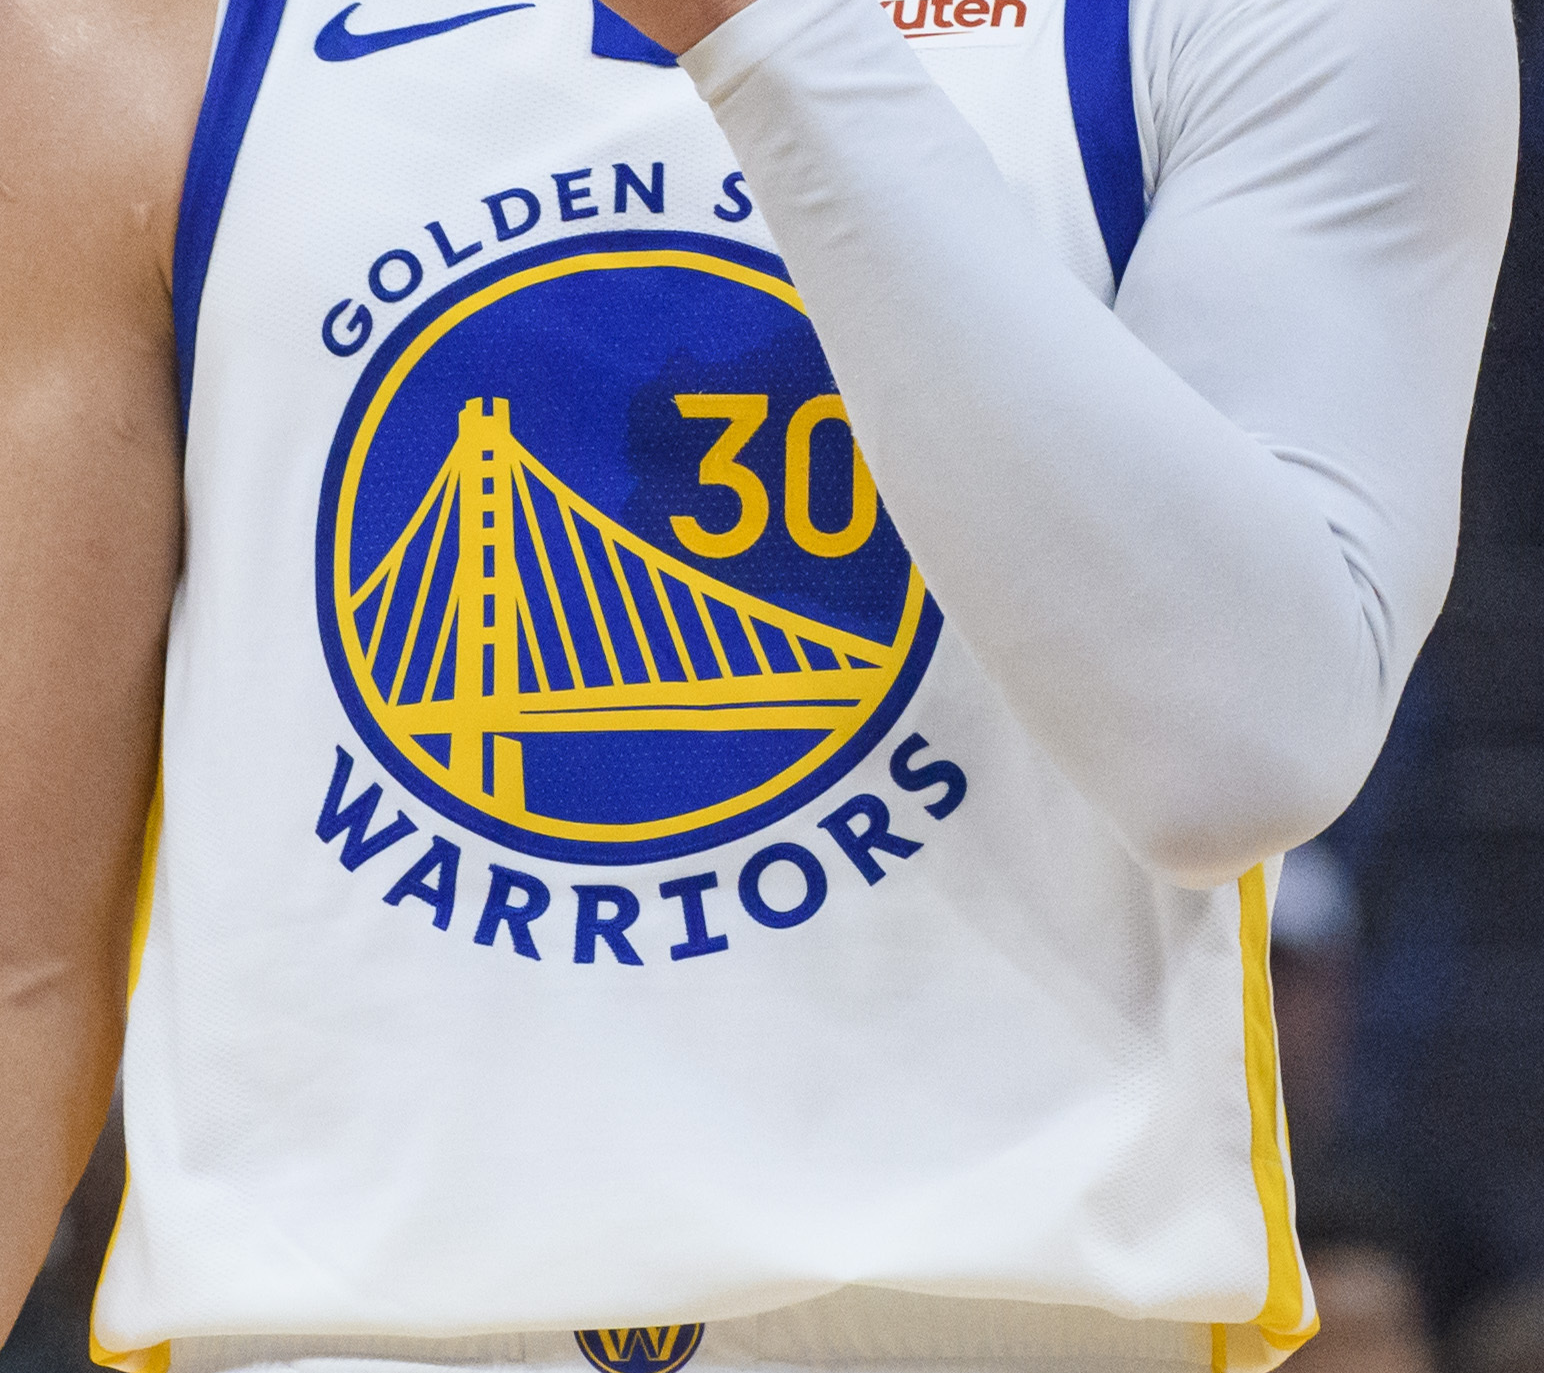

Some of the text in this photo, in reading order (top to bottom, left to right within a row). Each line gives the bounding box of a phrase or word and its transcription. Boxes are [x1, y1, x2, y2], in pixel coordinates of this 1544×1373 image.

[321, 161, 754, 358] GOLDEN S
[668, 393, 878, 559] 30
[314, 730, 969, 967] WARRIORS
